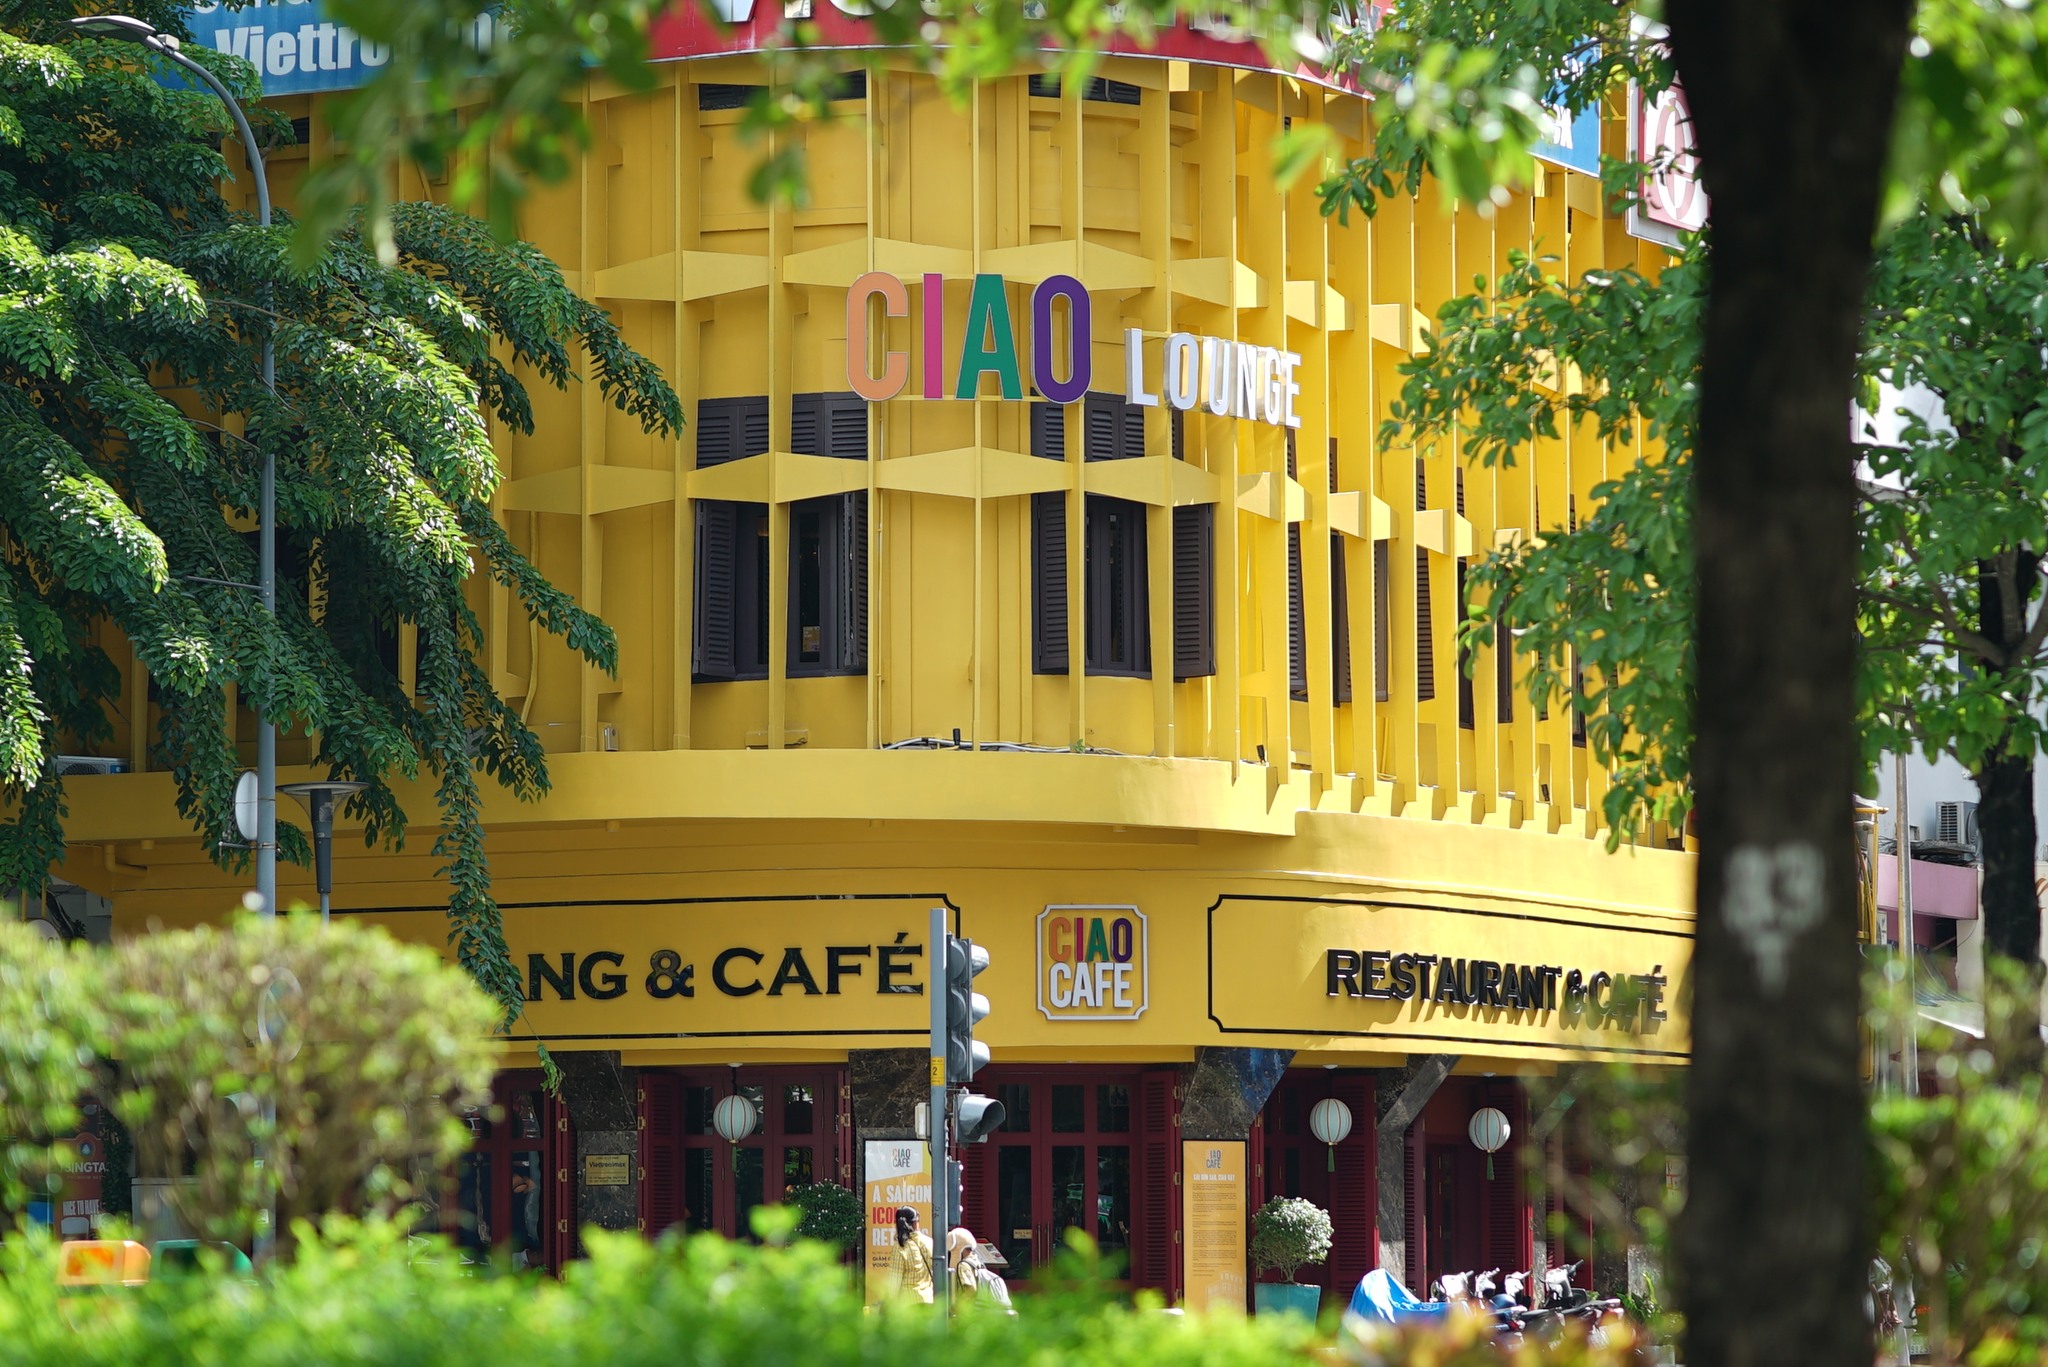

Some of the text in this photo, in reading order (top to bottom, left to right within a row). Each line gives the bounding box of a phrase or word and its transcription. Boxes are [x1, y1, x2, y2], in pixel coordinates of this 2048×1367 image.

[846, 271, 1302, 429] CIAO LOUNGE
[1048, 917, 1133, 962] CIAO
[645, 950, 695, 999] &
[712, 932, 924, 997] CAFÉ
[1049, 962, 1134, 1009] CAFE
[1326, 948, 1562, 1011] RESTAURANT
[1588, 964, 1668, 1022] CAFÉ
[892, 1148, 911, 1159] CIAO
[892, 1158, 911, 1168] CAFE
[1206, 1159, 1221, 1168] CAFE
[872, 1184, 932, 1203] A SAIGON
